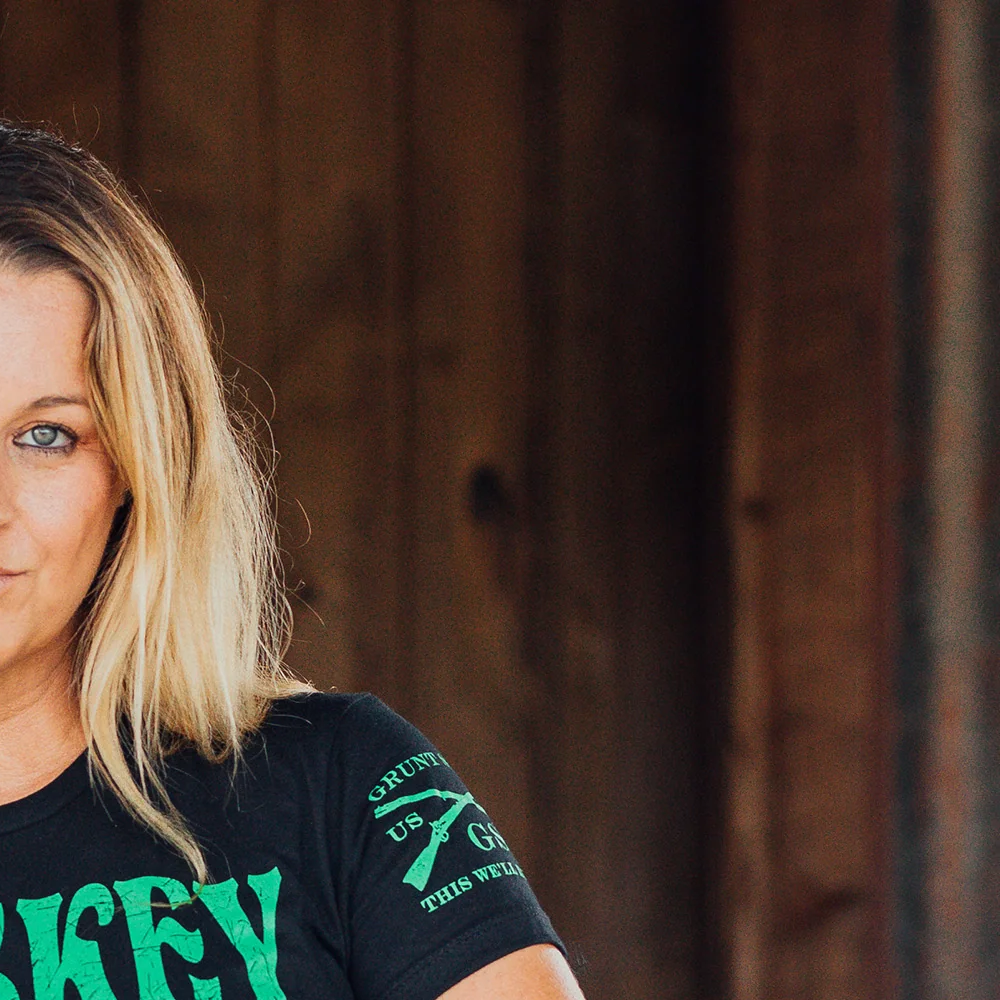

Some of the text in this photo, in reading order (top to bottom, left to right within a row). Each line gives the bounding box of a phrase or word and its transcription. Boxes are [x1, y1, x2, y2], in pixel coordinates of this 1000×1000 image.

[368, 752, 440, 801] GRUNT
[386, 812, 423, 841] US
[420, 876, 473, 912] THIS
